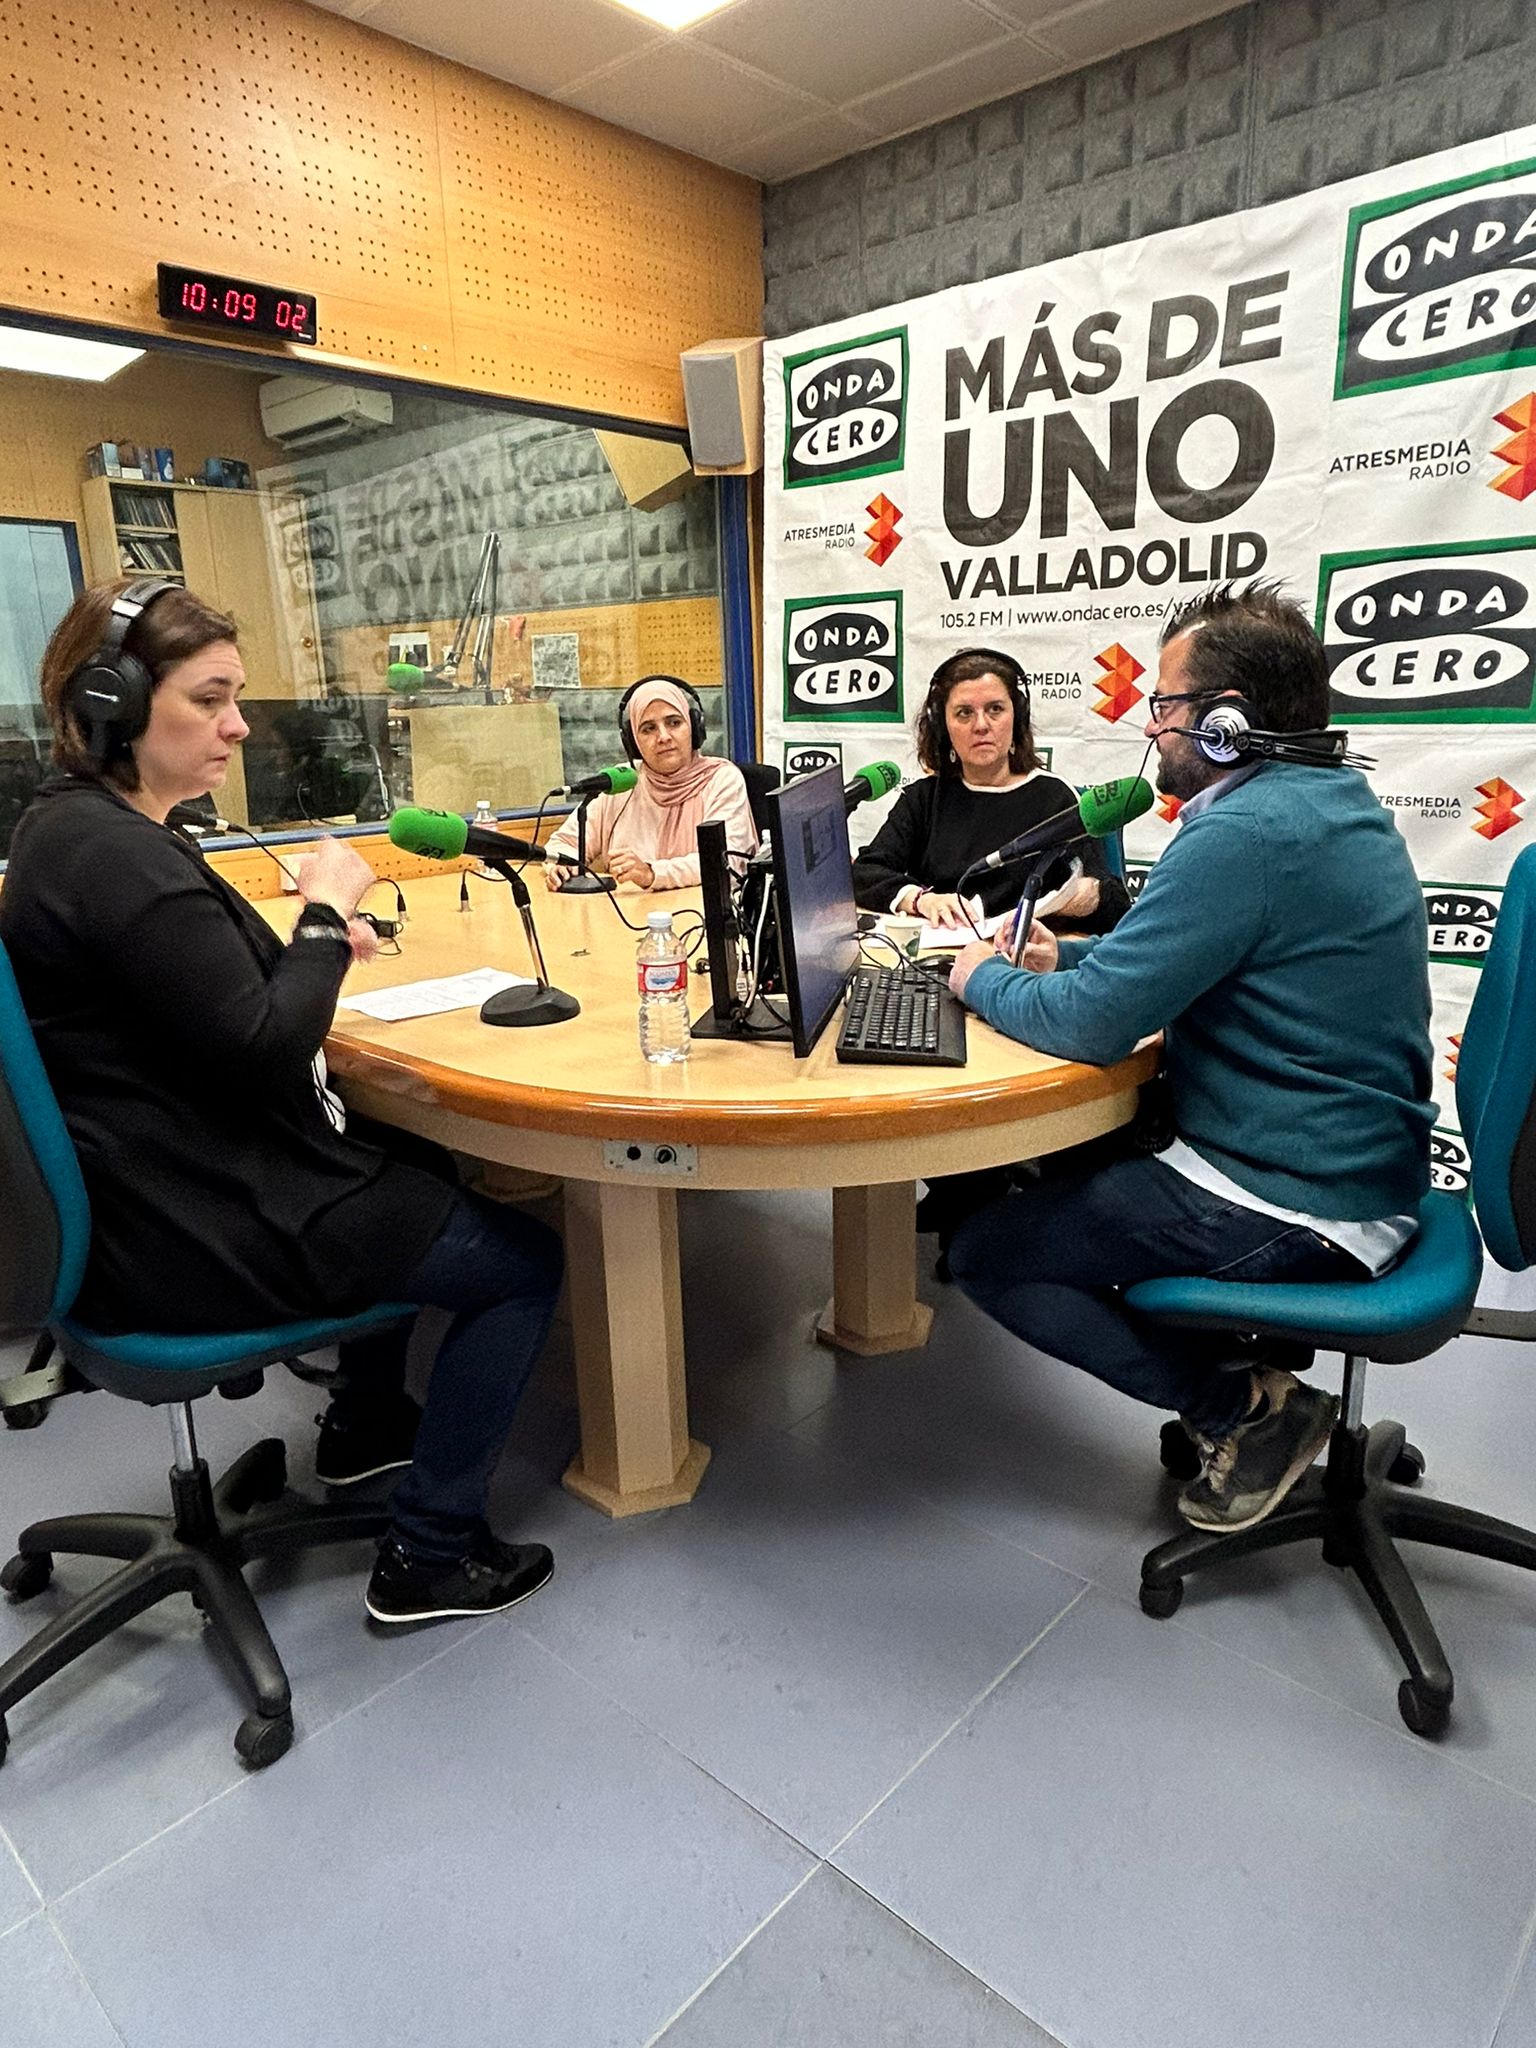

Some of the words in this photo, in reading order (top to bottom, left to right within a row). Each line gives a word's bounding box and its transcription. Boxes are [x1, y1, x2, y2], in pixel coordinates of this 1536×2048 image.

[1384, 208, 1536, 281] ONDA
[181, 283, 257, 321] 10:09
[276, 301, 307, 331] 02
[1386, 282, 1536, 347] CERO
[945, 301, 1122, 422] MÁS
[1146, 270, 1290, 382] DE
[805, 368, 886, 411] ONDA
[807, 418, 886, 456] CERO
[943, 378, 1275, 548] UNO
[1329, 438, 1472, 475] ATRESMEDIA
[1409, 460, 1472, 481] RADIO
[784, 522, 856, 543] ATRESMEDIA
[825, 536, 856, 550] RADIO
[940, 531, 1268, 601] VALLADOLID
[1351, 585, 1508, 626] ONDA
[940, 611, 976, 629] 105.2
[980, 610, 1003, 626] FM
[803, 625, 881, 652] ONDA
[1356, 648, 1502, 687] CERO
[806, 669, 881, 695] CERO
[1041, 688, 1082, 700] RADIO
[793, 756, 834, 768] ONDA
[1378, 795, 1462, 808] TRESMEDIA
[1420, 809, 1462, 819] RADIO
[1431, 902, 1490, 919] NDA
[1433, 929, 1486, 947] ERO
[1431, 1142, 1459, 1161] DA
